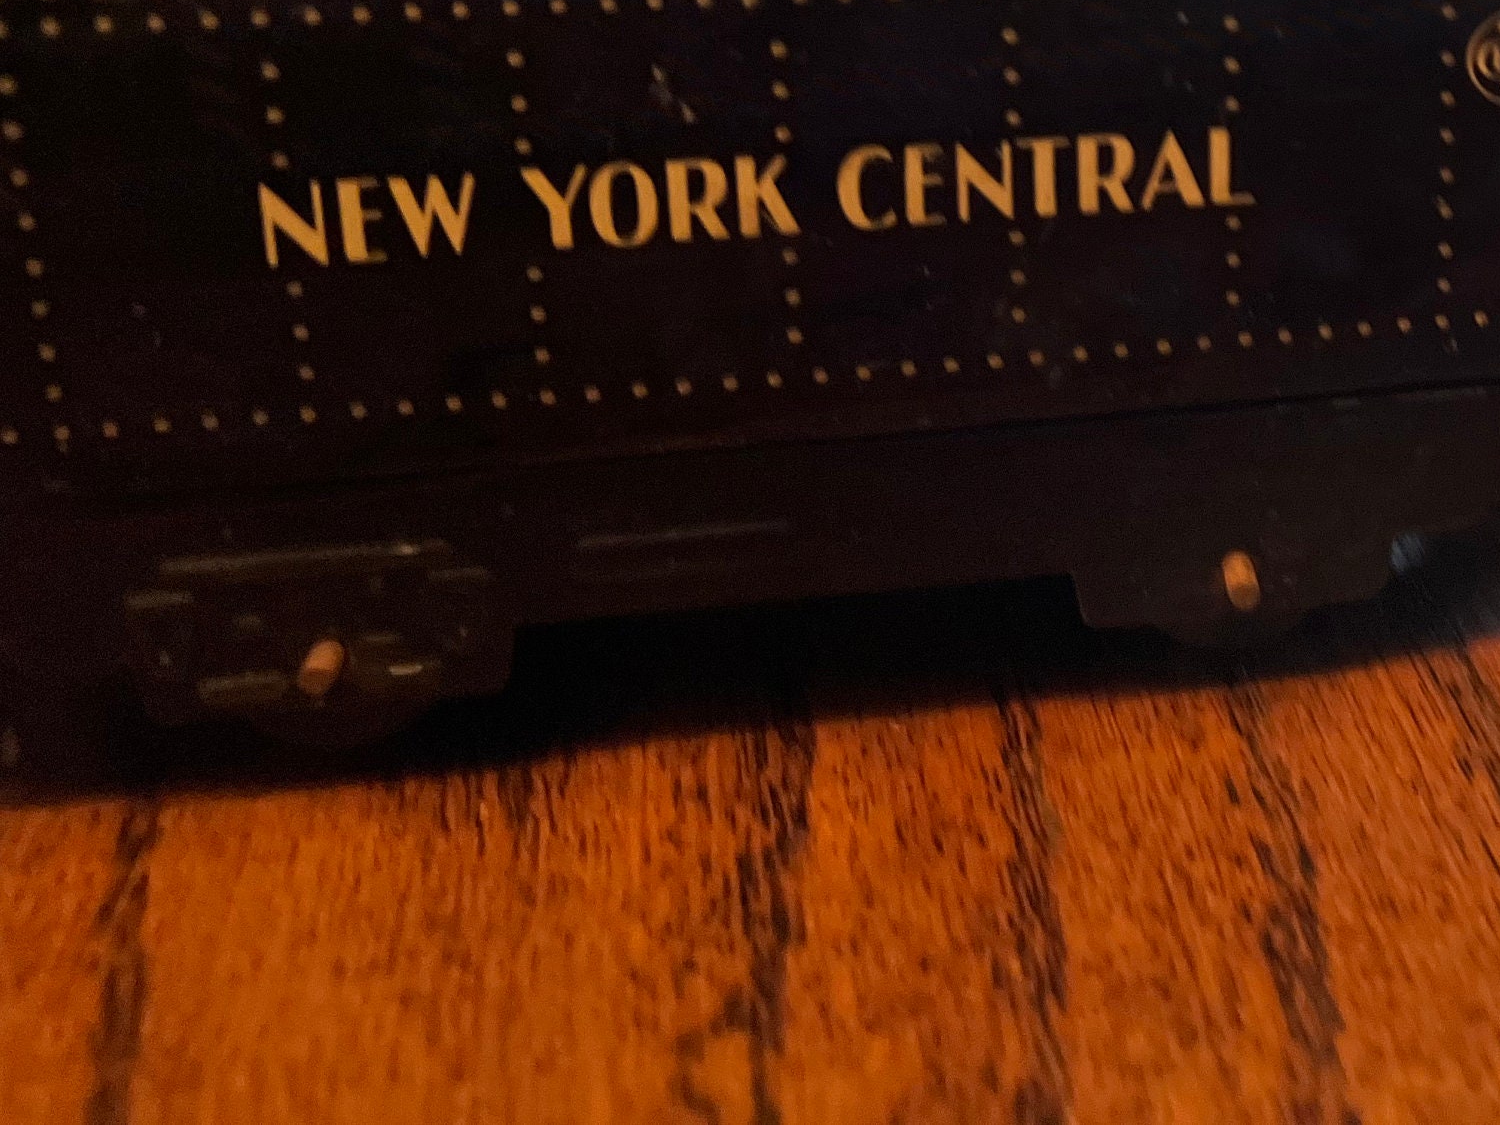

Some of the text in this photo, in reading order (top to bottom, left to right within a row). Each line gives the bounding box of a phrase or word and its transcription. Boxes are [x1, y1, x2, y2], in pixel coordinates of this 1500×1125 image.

[258, 125, 1257, 268] NEW YORK CENTRAL
